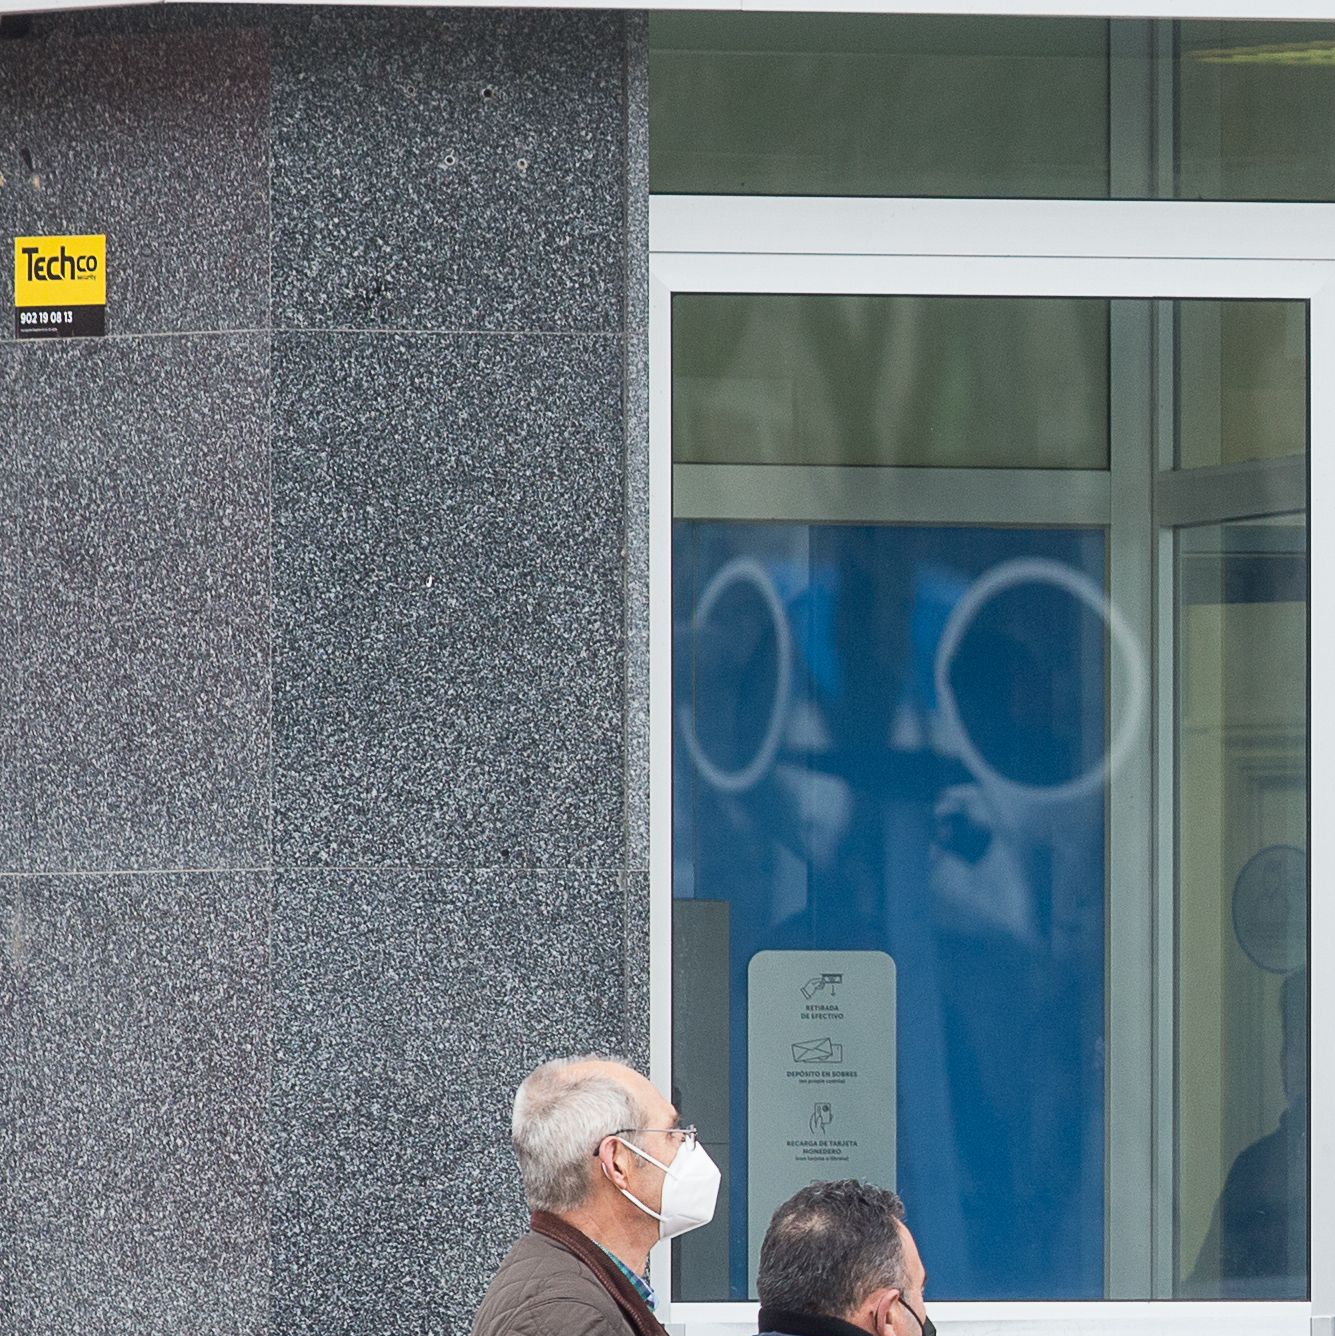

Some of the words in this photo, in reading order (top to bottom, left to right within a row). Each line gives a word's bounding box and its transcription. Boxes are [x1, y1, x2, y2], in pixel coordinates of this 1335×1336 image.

[22, 246, 97, 281] Techco
[20, 312, 37, 324] 902
[39, 312, 48, 323] 19
[50, 312, 62, 323] 08
[64, 311, 72, 323] 13
[805, 1004, 839, 1012] RETIRADA
[786, 1070, 820, 1078] DEPÓSITO
[786, 1140, 817, 1148] RECARGA
[829, 1140, 858, 1148] TARJETA
